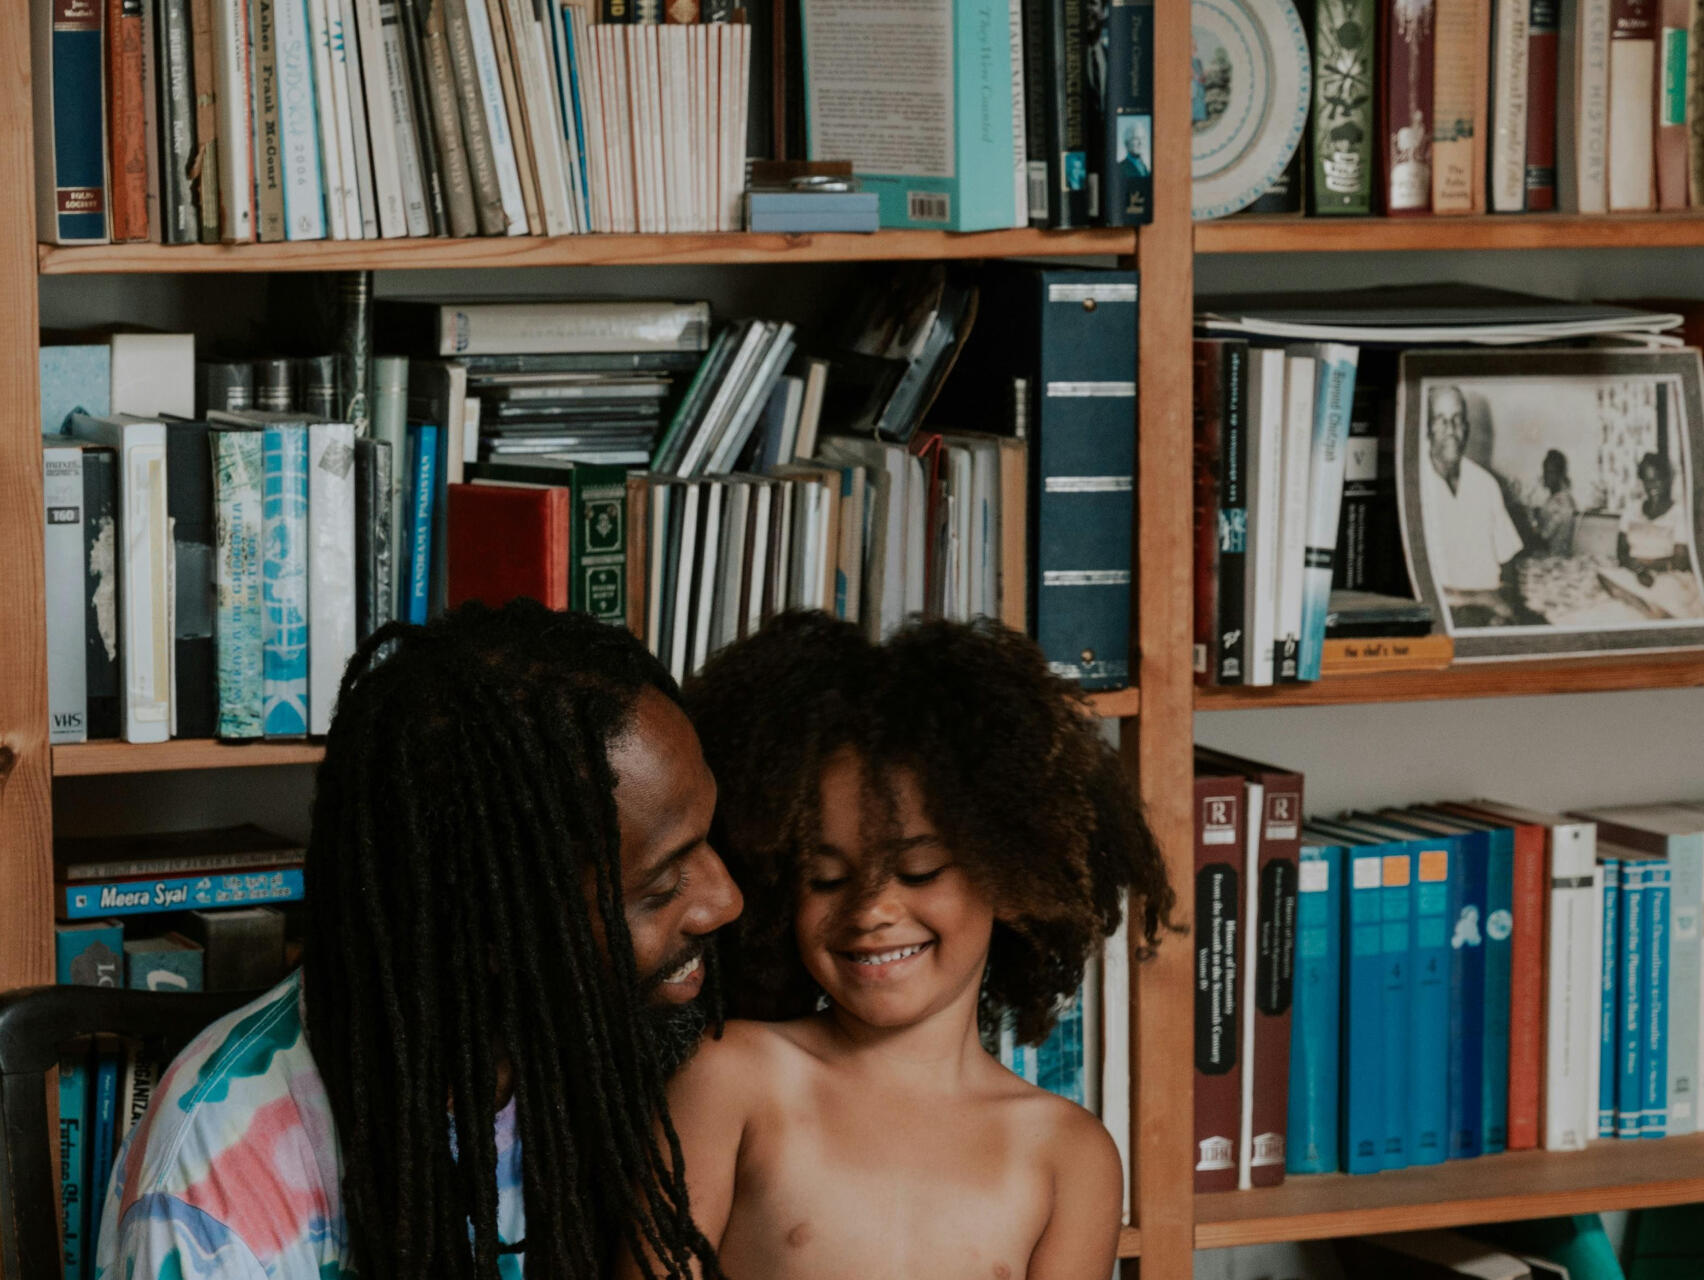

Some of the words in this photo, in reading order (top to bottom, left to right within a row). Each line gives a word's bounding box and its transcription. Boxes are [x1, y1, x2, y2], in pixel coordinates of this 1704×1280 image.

[977, 6, 991, 42] They
[1590, 0, 1605, 71] ECRET
[453, 18, 470, 79] ALMANACK
[979, 47, 992, 81] Were
[263, 65, 275, 114] Frank
[463, 84, 480, 131] SPENCER
[980, 86, 994, 143] Counted
[1588, 85, 1603, 184] HISTORY
[265, 120, 278, 190] McCourt
[294, 144, 307, 186] 2006
[472, 135, 489, 184] STANLEY
[418, 456, 430, 517] PAKISTAN
[415, 526, 428, 597] PANORAMA
[54, 713, 82, 727] VHS
[1211, 802, 1226, 824] R
[1275, 798, 1288, 820] R
[100, 887, 150, 909] Meera
[153, 883, 187, 904] Syal
[223, 876, 242, 888] Life
[1212, 874, 1223, 898] From
[1212, 902, 1223, 915] the
[1224, 920, 1236, 956] History
[1212, 966, 1222, 980] the
[1225, 957, 1235, 968] of
[1223, 970, 1235, 1015] Humanity
[1210, 1026, 1222, 1064] Century
